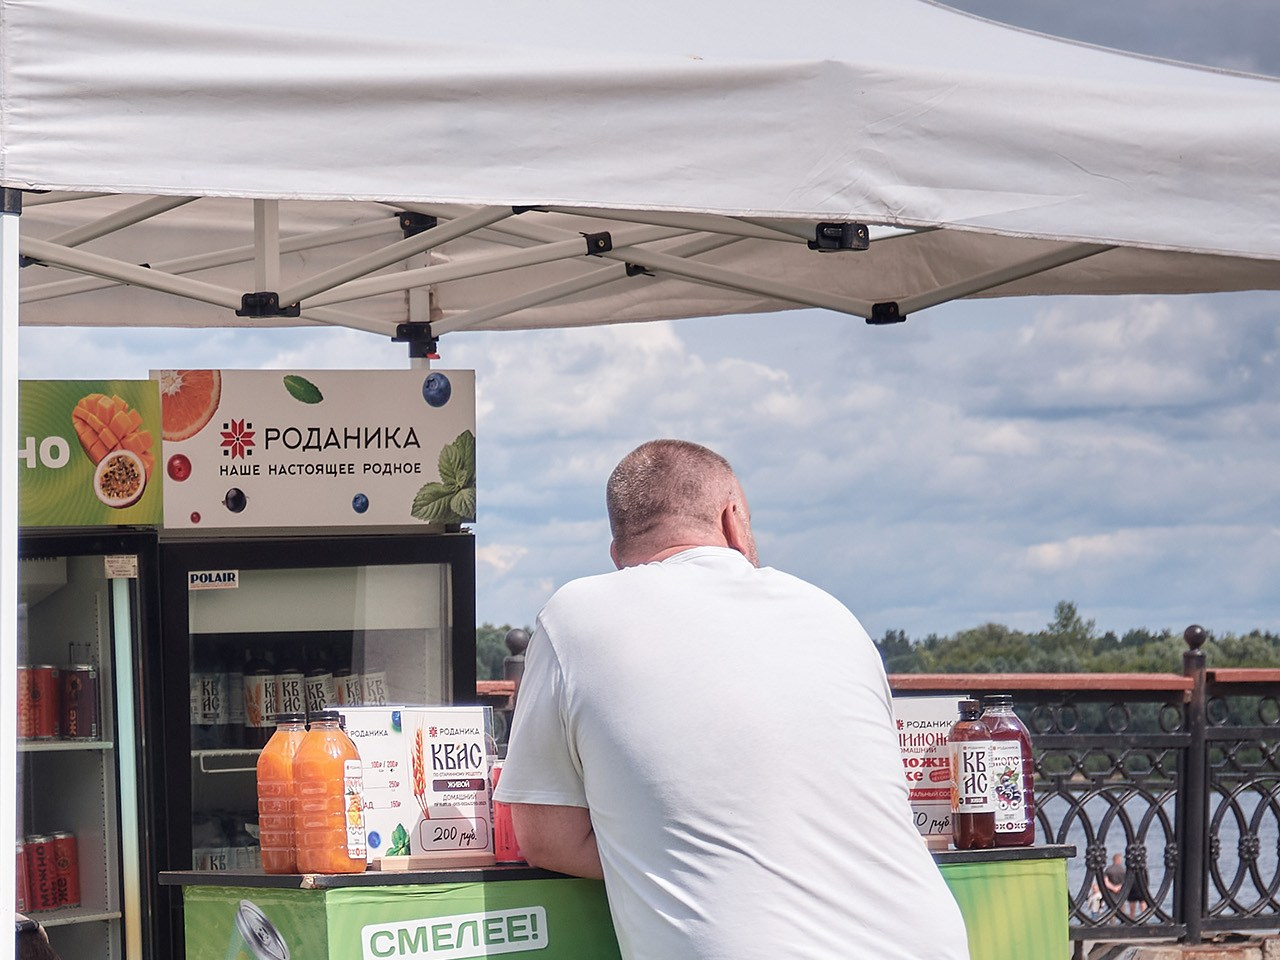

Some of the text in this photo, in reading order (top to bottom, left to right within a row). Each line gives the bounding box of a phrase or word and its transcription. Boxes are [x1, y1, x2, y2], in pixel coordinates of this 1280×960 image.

[265, 427, 421, 452] РОДАНИКА
[220, 463, 421, 476] НАШЕ НАСТОЯЩЕЕ РОДНОЕ
[190, 571, 236, 584] POLAIR
[282, 679, 299, 696] КВ
[307, 681, 324, 698] КВ
[284, 697, 300, 712] АС
[440, 727, 480, 735] РОДАНИКА
[899, 733, 949, 746] ИМОН
[431, 743, 482, 770] КВАС
[963, 752, 986, 773] КВ
[963, 774, 988, 794] АС
[433, 827, 476, 846] 200 руб.
[369, 914, 539, 958] СМЕЛЕЕ!
